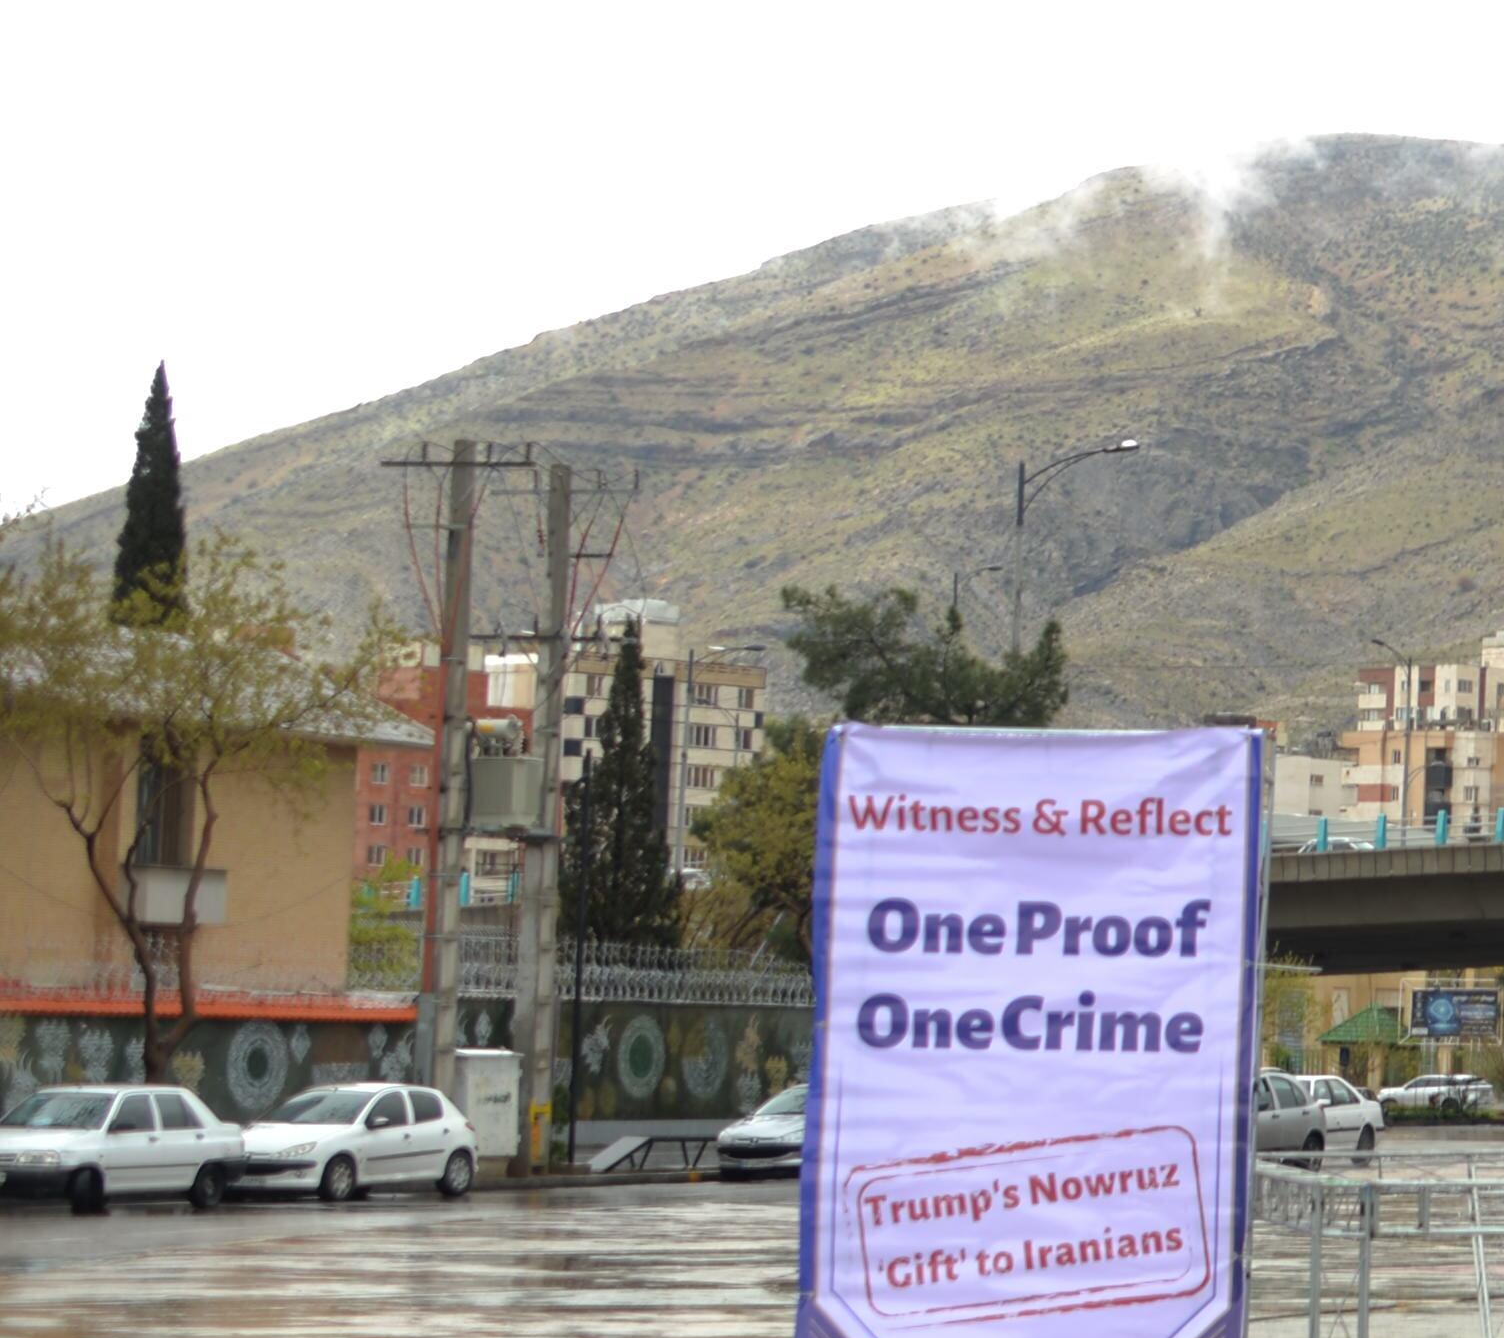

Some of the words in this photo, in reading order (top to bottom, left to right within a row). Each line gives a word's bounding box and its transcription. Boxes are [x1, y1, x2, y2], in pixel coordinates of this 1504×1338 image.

[848, 794, 1022, 835] Witness
[1033, 799, 1067, 835] &
[1080, 798, 1233, 837] Reflect
[867, 897, 1008, 956] One
[1017, 899, 1212, 958] Proof
[857, 993, 995, 1050] One
[1001, 991, 1205, 1054] Crime
[864, 1178, 1021, 1229] Trump's
[1029, 1163, 1181, 1208] Nowruz
[976, 1243, 1015, 1276] to
[1023, 1225, 1184, 1271] Iranians
